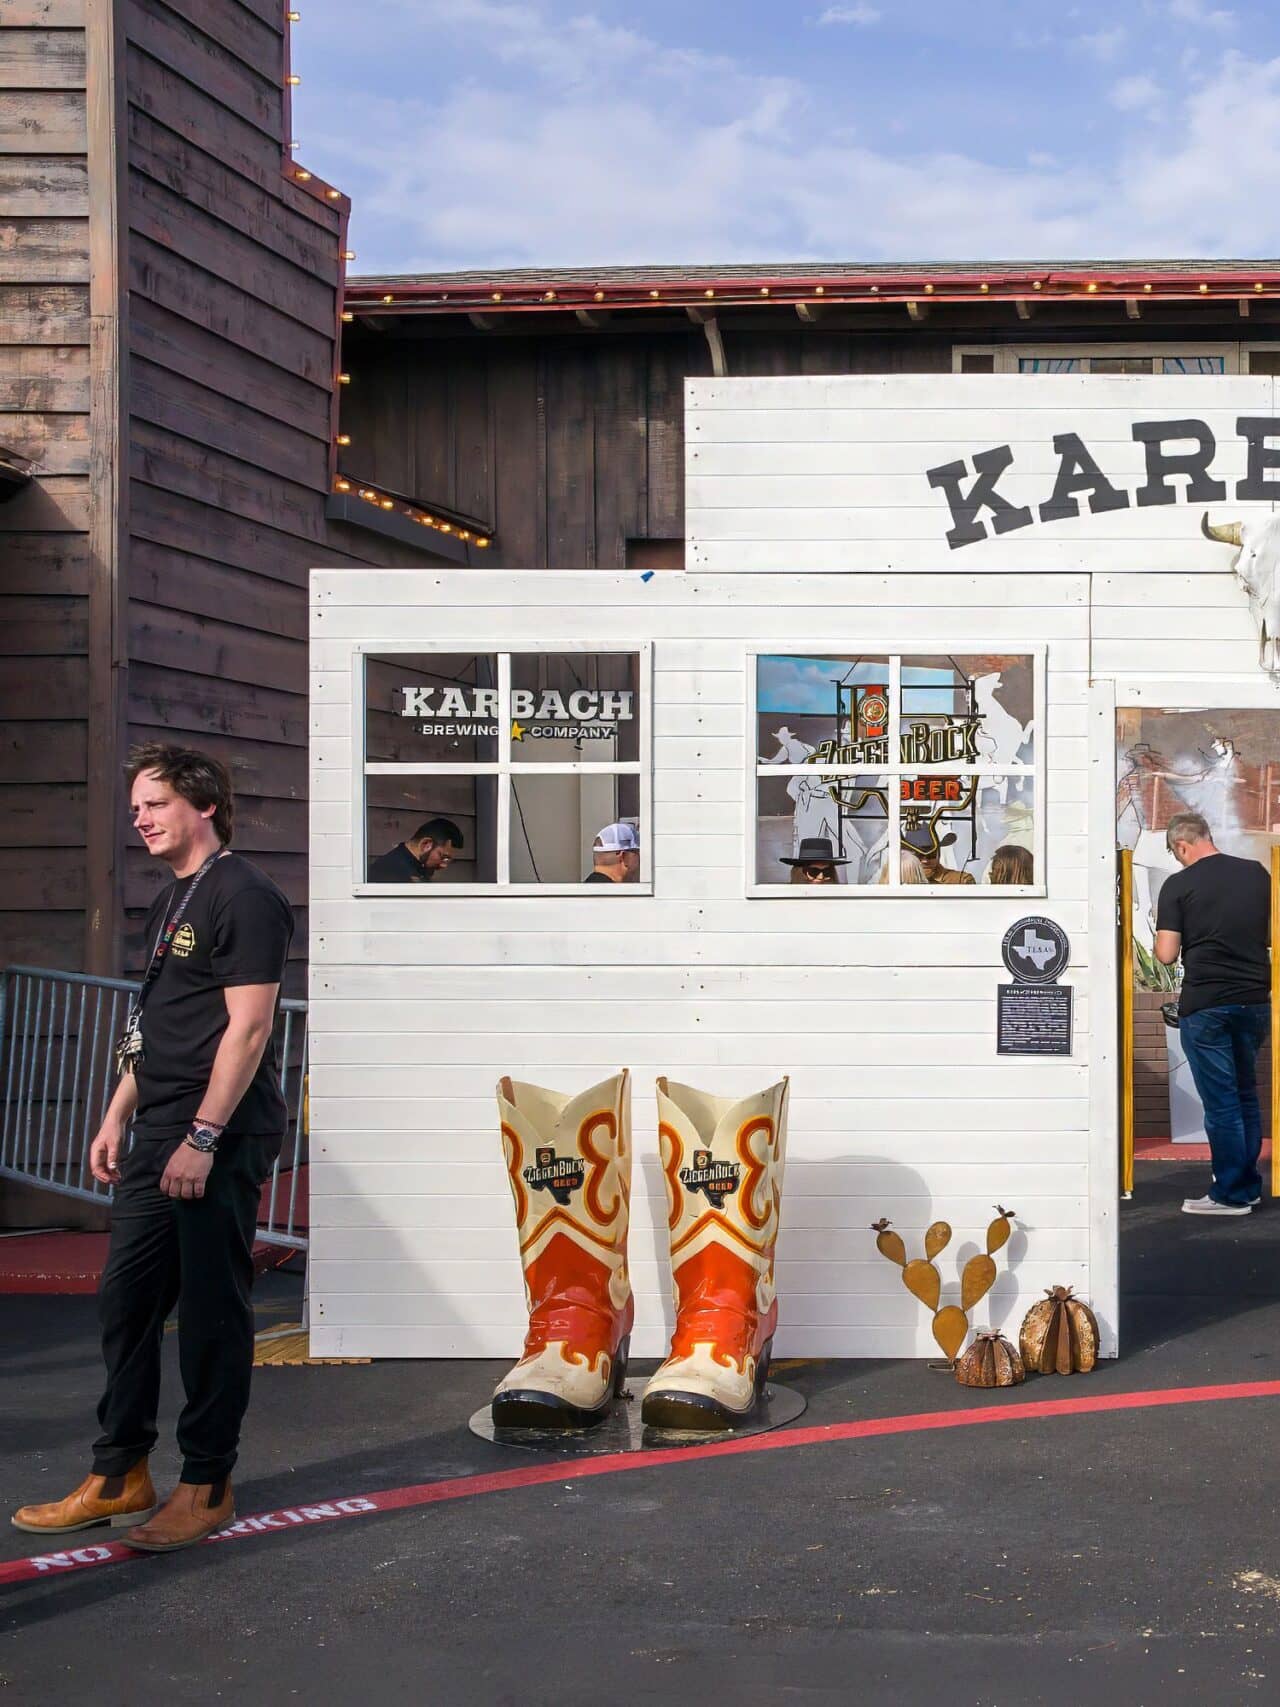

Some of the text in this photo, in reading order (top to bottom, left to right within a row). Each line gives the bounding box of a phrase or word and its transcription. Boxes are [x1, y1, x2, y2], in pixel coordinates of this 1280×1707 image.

[401, 687, 634, 720] KARBACH
[422, 724, 614, 739] BREWING COMPANY
[900, 780, 961, 801] BEER
[29, 1498, 378, 1571] NO RKING
